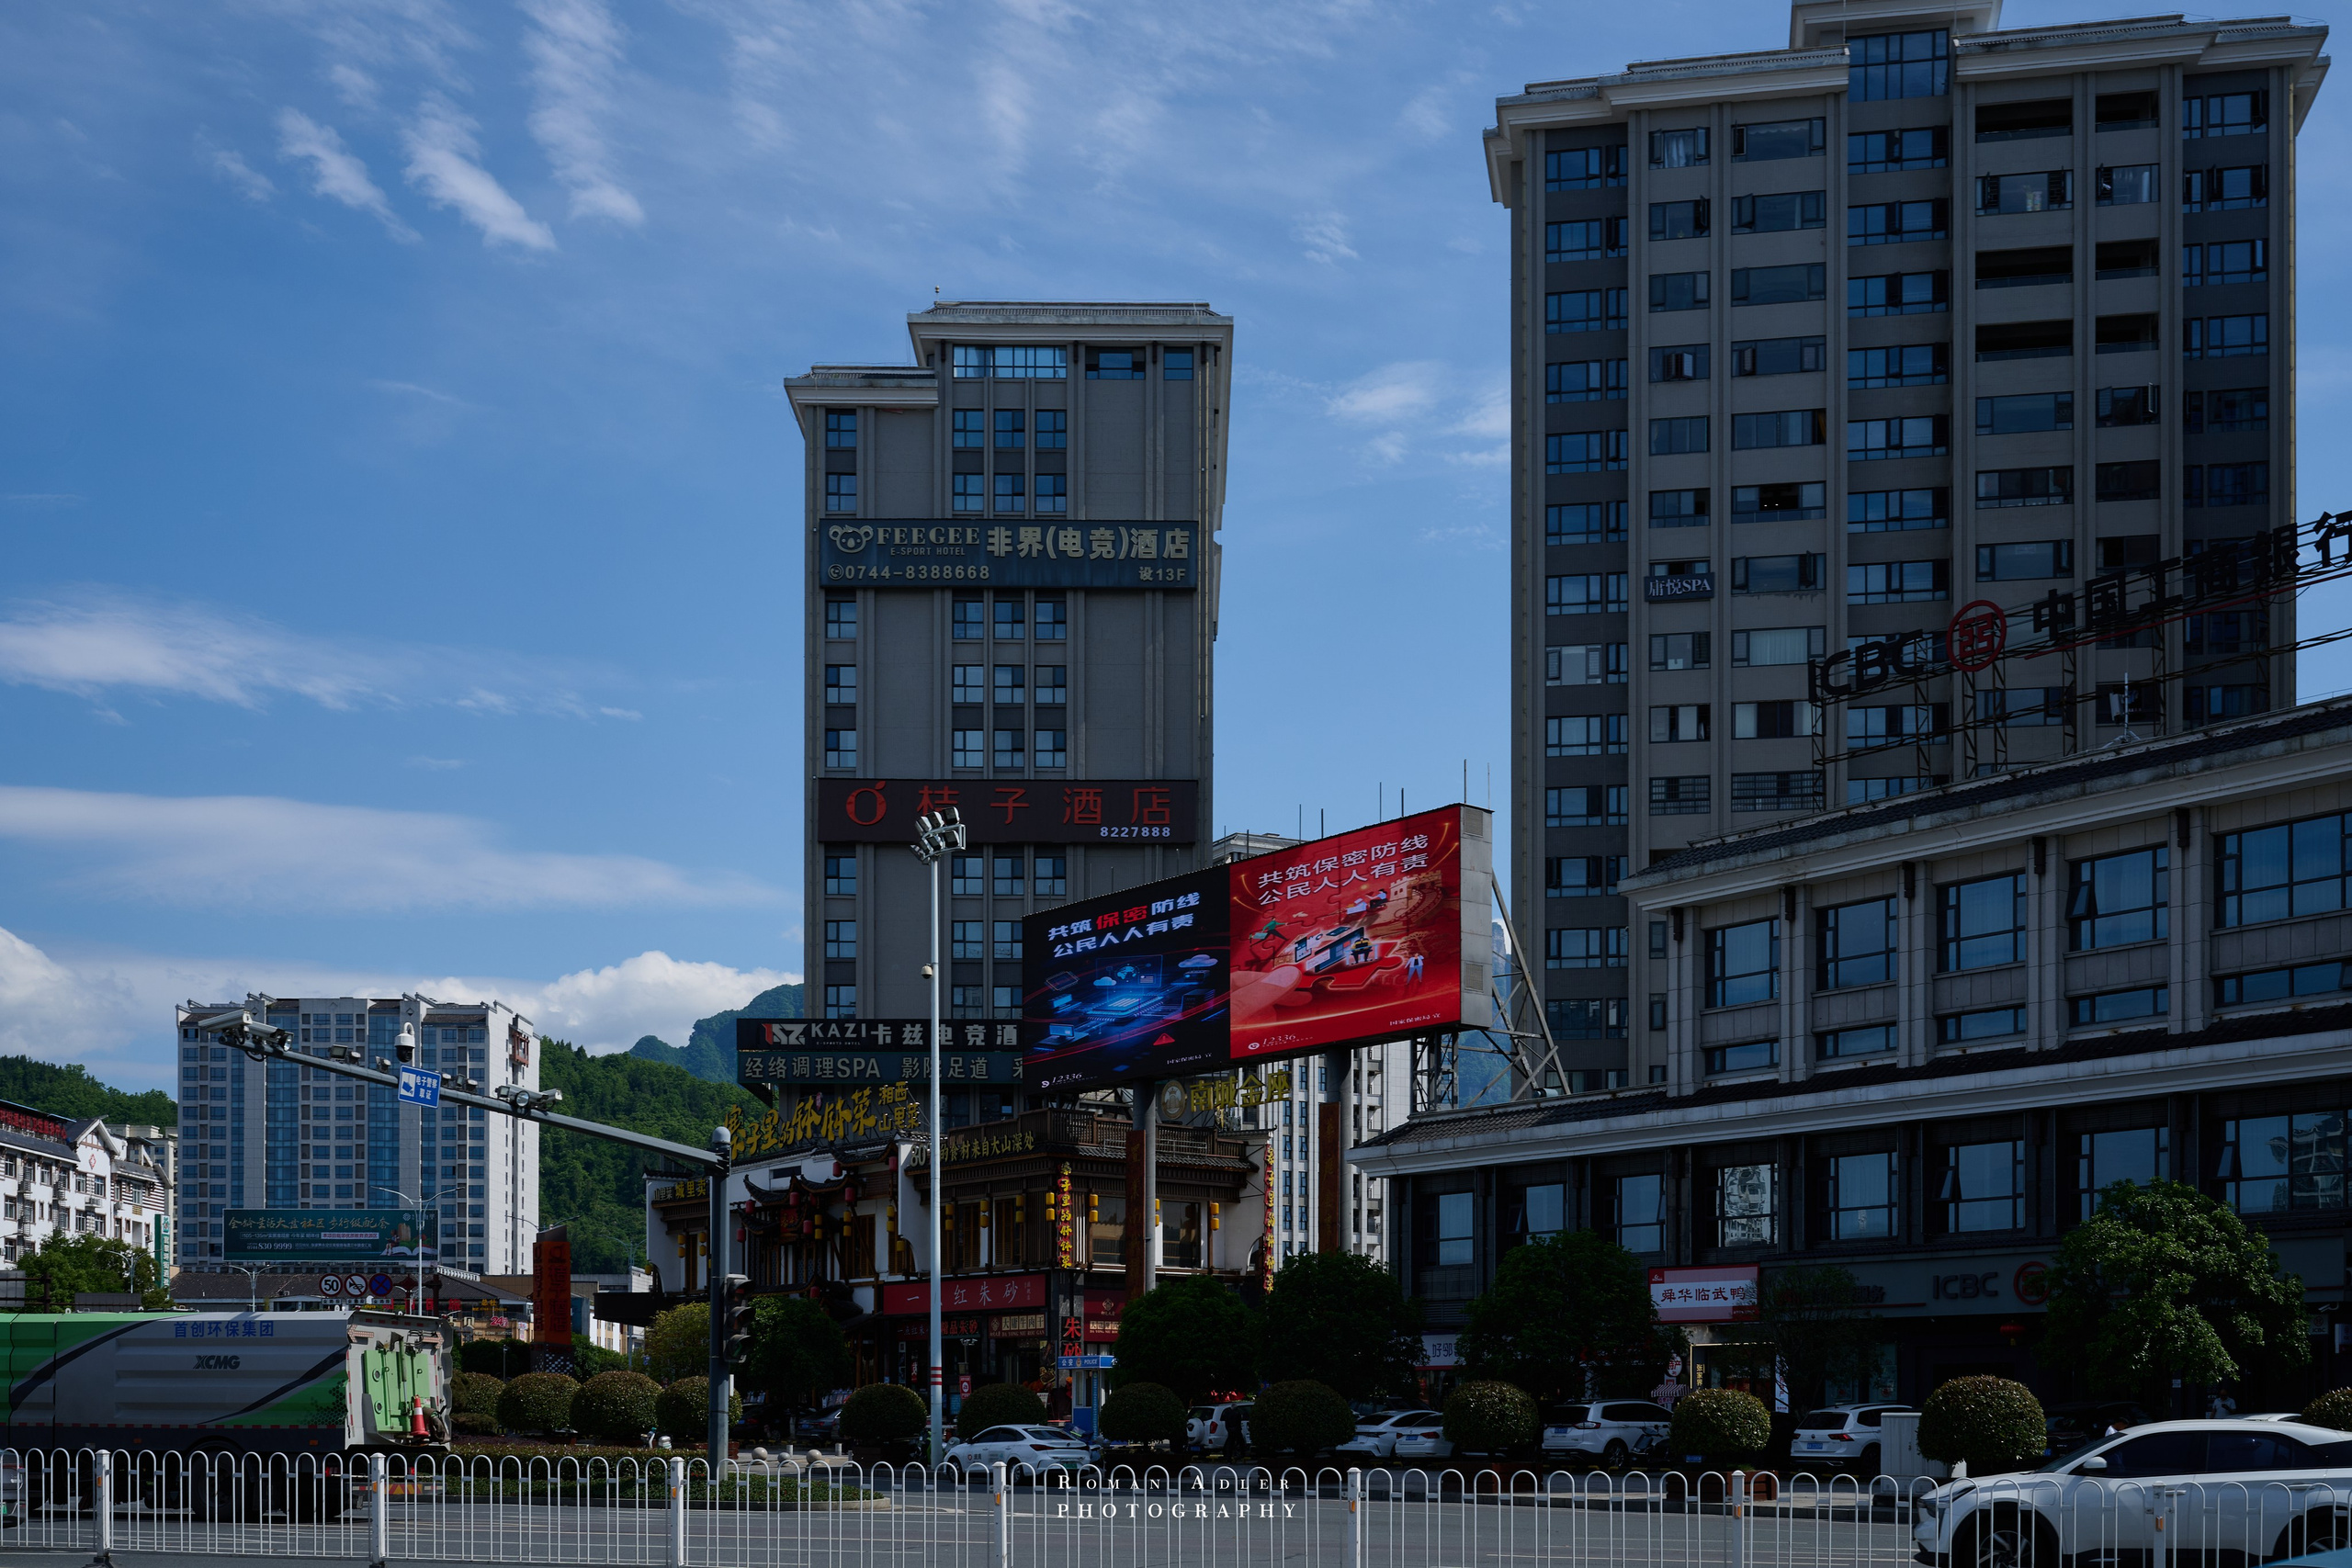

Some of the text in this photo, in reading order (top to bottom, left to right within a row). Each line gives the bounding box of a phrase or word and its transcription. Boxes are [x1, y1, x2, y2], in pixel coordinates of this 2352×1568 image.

[876, 527, 980, 545] FEEGEE
[986, 525, 1190, 560] 非界(电竞)酒店
[890, 547, 966, 556] E-SPORT HOTEL
[845, 565, 990, 580] 0744-8388668
[1138, 567, 1186, 581] 设13F
[1808, 629, 1923, 704] ICBC
[1099, 827, 1171, 838] 8227888
[1258, 834, 1429, 889] 共筑保密防线
[1258, 853, 1430, 906] 公民人人有责
[1047, 892, 1201, 941] 共筑保密防线
[1053, 913, 1194, 958] 公民人人有责
[811, 1022, 866, 1038] KAZI
[1262, 1032, 1296, 1045] 12336
[745, 1056, 882, 1079] 经络调理SPA
[416, 1075, 437, 1089] 电子警察
[1051, 1071, 1082, 1084] 12336
[419, 1088, 432, 1100] 取证
[1190, 1069, 1292, 1112] 南城金座
[910, 1130, 1035, 1168] 80的食材来自大山深处
[323, 1280, 339, 1292] 50
[907, 1280, 1019, 1306] 一红朱砂
[1932, 1271, 1998, 1300] ICBC
[1661, 1286, 1747, 1303] 舜华临武鸭
[174, 1321, 274, 1337] 首创环保集团
[897, 1324, 929, 1336] 一点红朱
[193, 1355, 241, 1370] XCMG
